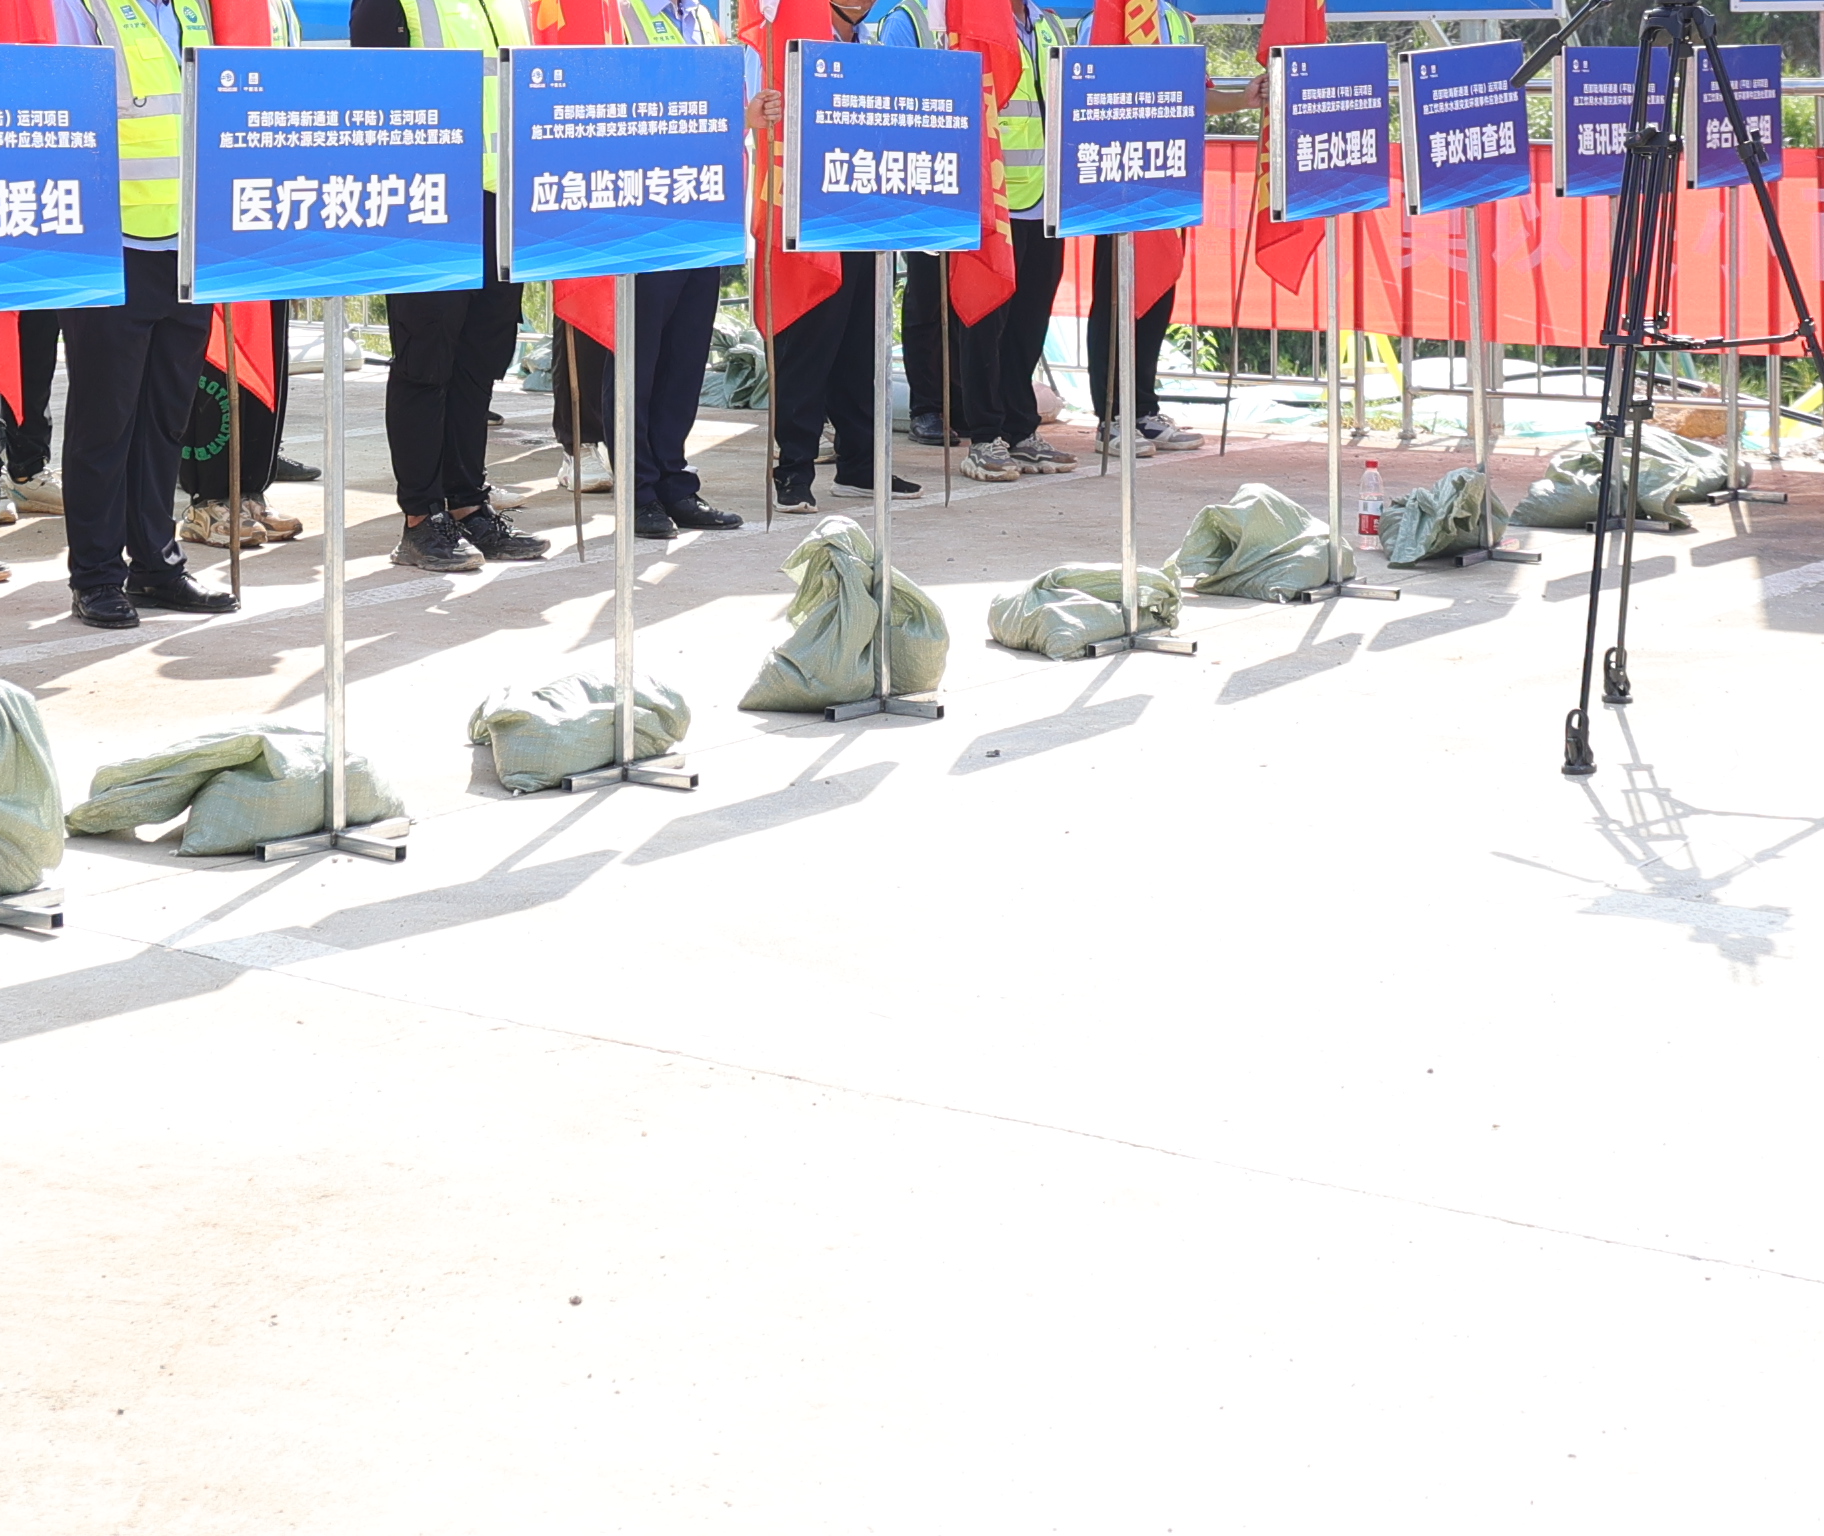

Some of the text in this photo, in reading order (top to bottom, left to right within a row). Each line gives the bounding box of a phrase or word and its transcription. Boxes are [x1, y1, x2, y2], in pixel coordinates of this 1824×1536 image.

[219, 128, 464, 148] 施工饮用水水源突发环境事件应急处置演练
[1077, 138, 1187, 185] 警戒保卫组
[1296, 128, 1377, 173] 善后处理组
[1429, 121, 1517, 168] 事故调查组
[530, 164, 725, 213] 应急监测专家组
[821, 148, 959, 195] 应急保障组
[232, 173, 449, 232] 医疗救护组
